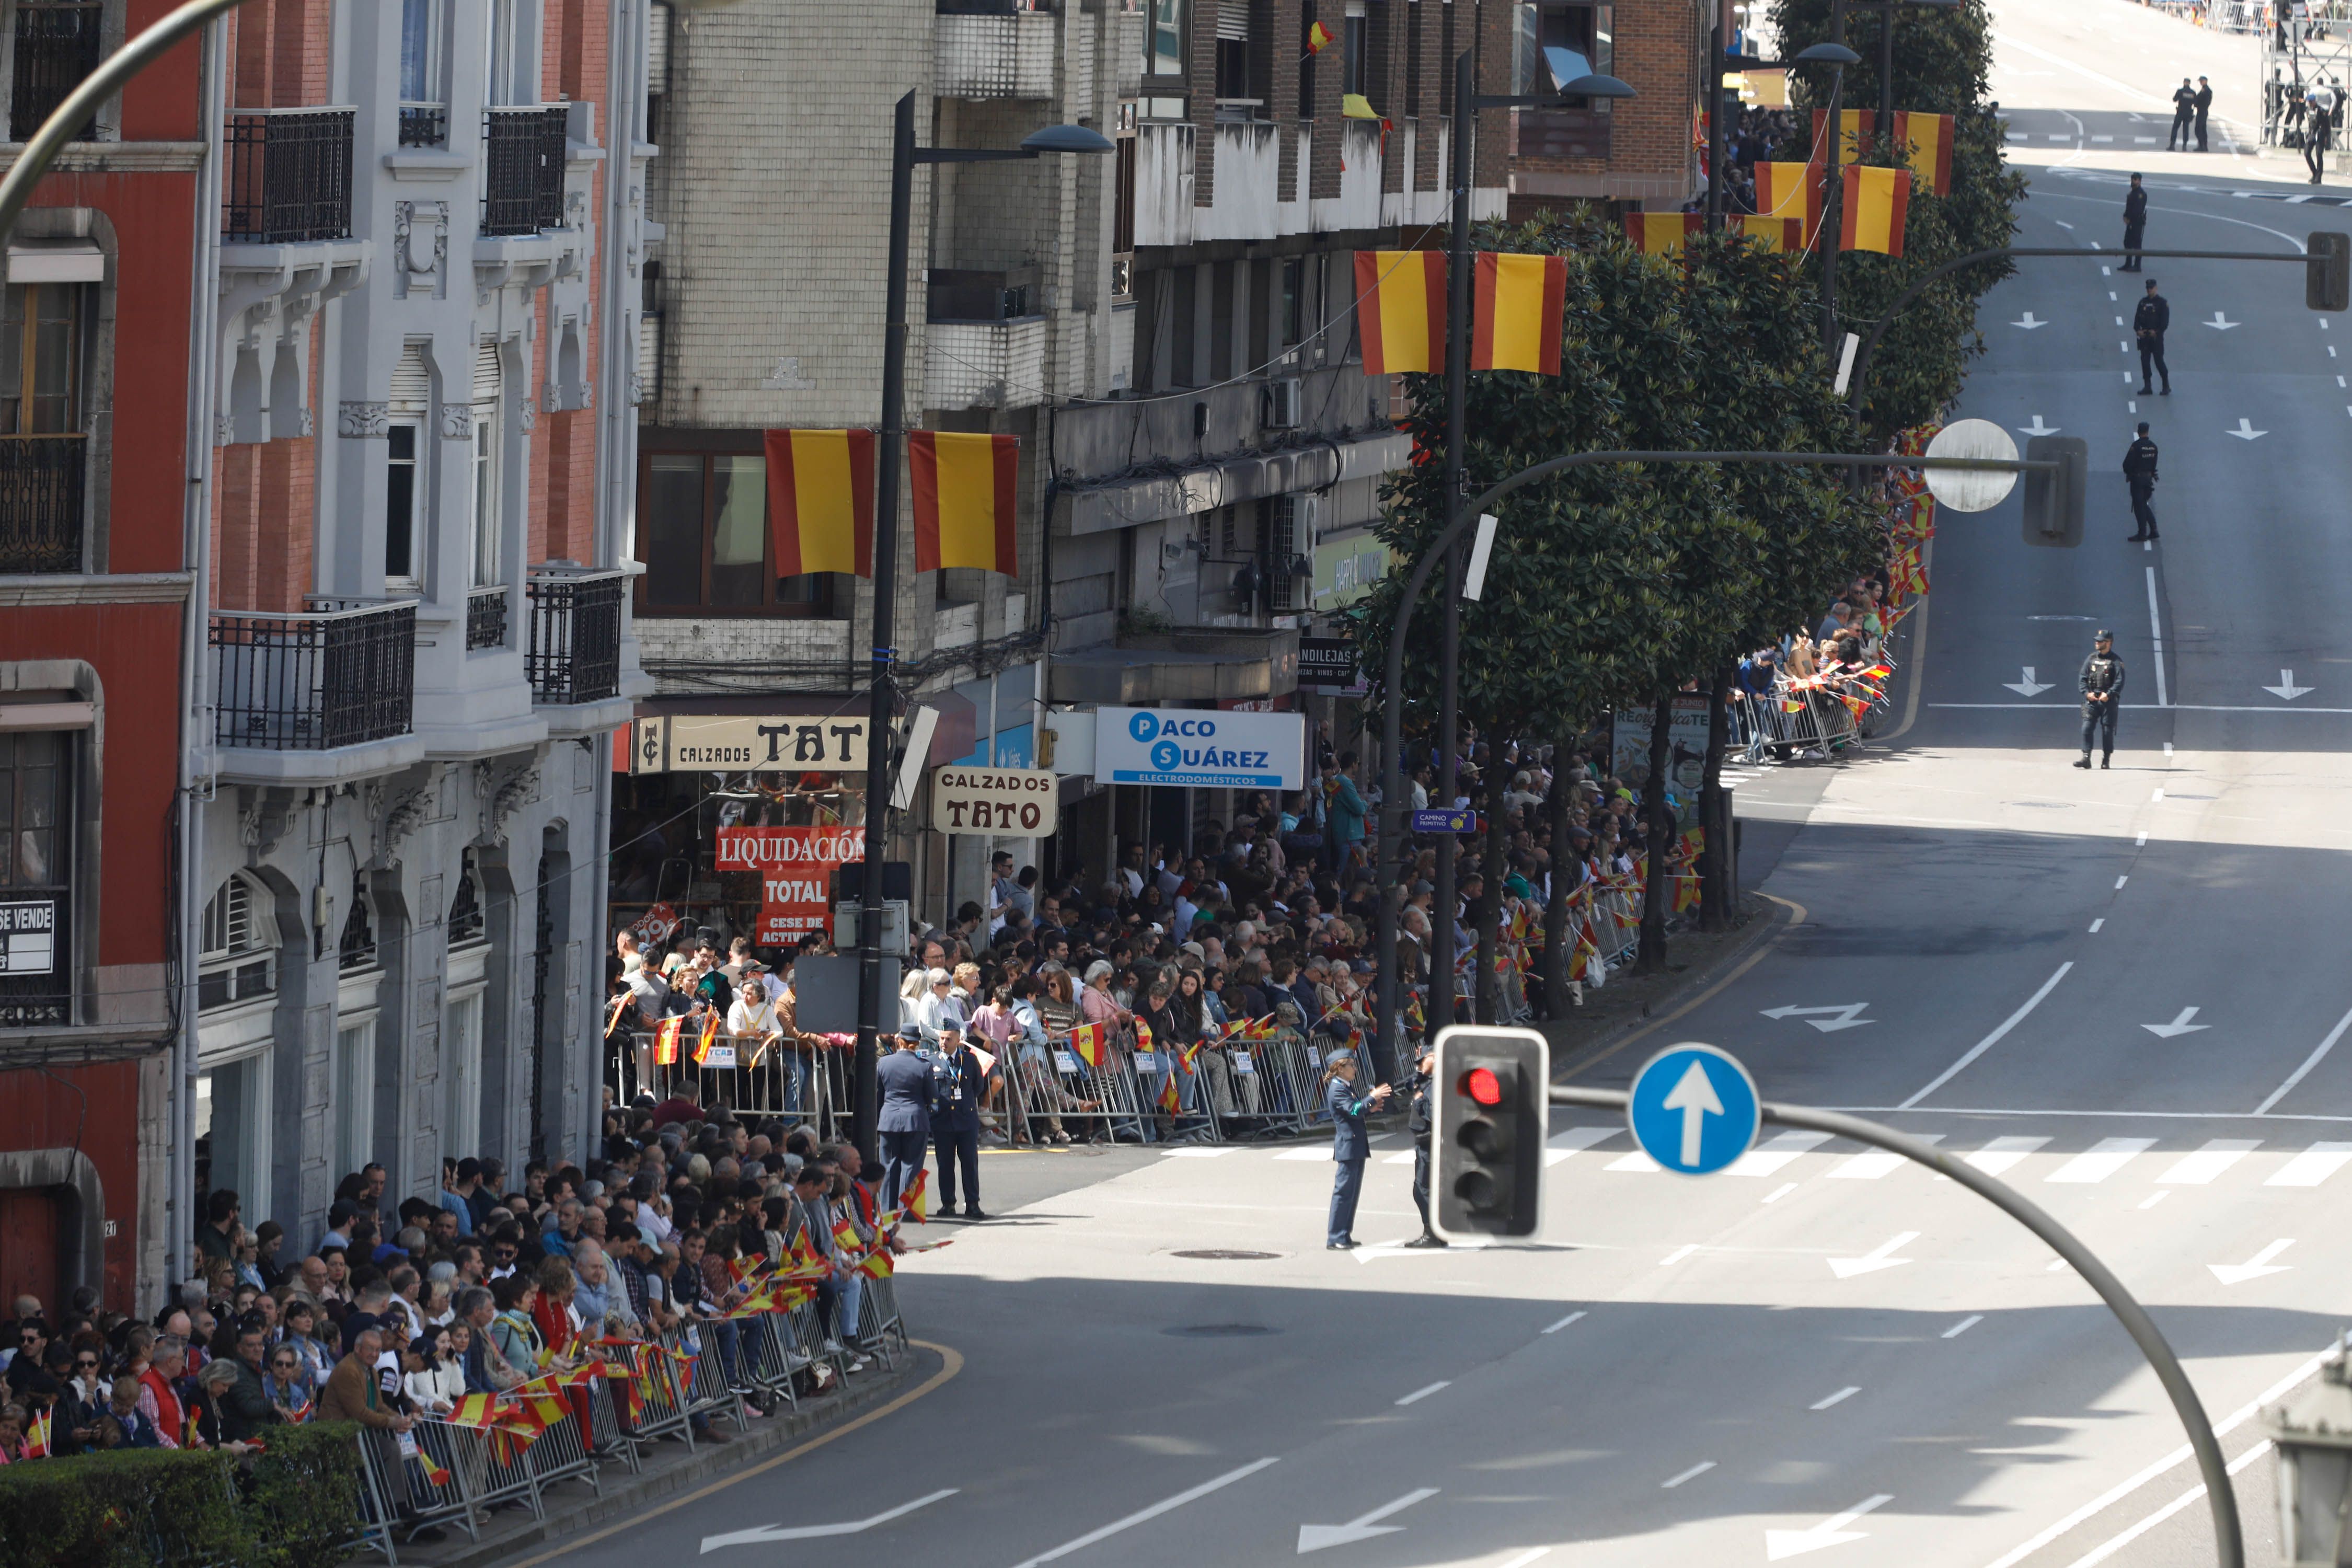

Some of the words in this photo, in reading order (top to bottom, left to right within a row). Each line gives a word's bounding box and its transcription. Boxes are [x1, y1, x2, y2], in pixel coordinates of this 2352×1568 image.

[1335, 557, 1353, 593] HAPPY
[1298, 649, 1351, 663] NDILEJAS
[1138, 719, 1216, 737] PACO
[680, 747, 750, 763] CALZADOS
[758, 723, 892, 762] TAT
[1160, 746, 1269, 769] SUÁREZ
[941, 774, 1050, 792] CALZADOS
[1138, 774, 1256, 785] ELECTRODOMÉSTICOS
[947, 800, 1041, 830] TATO
[766, 880, 826, 903] TOTAL
[14, 907, 51, 929] VENDE
[770, 917, 803, 928] CESE
[806, 917, 824, 928] DE
[107, 1223, 114, 1235] 21
